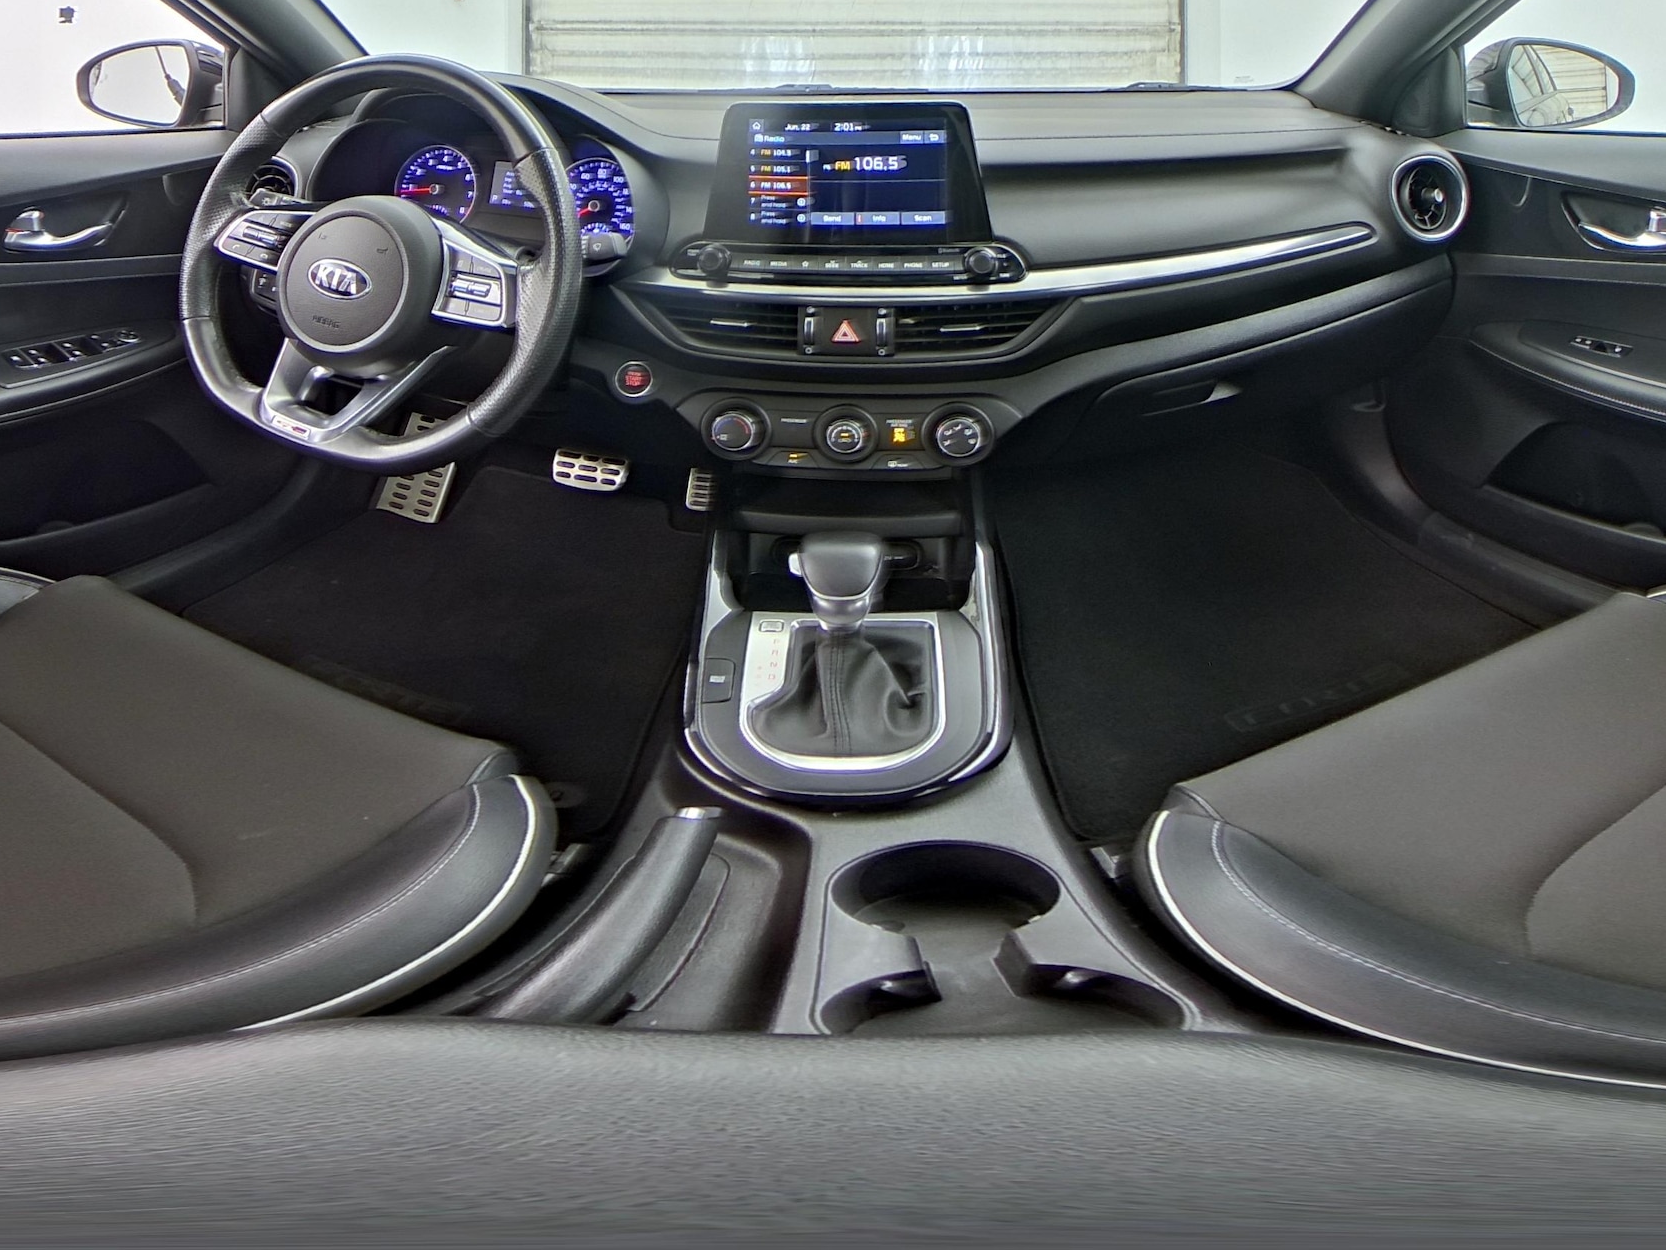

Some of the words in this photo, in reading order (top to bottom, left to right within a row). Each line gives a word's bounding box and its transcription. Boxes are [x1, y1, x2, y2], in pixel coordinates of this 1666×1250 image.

[834, 122, 853, 131] 2:01
[835, 161, 851, 170] FM
[854, 156, 899, 170] 106.5
[315, 264, 356, 294] KIA
